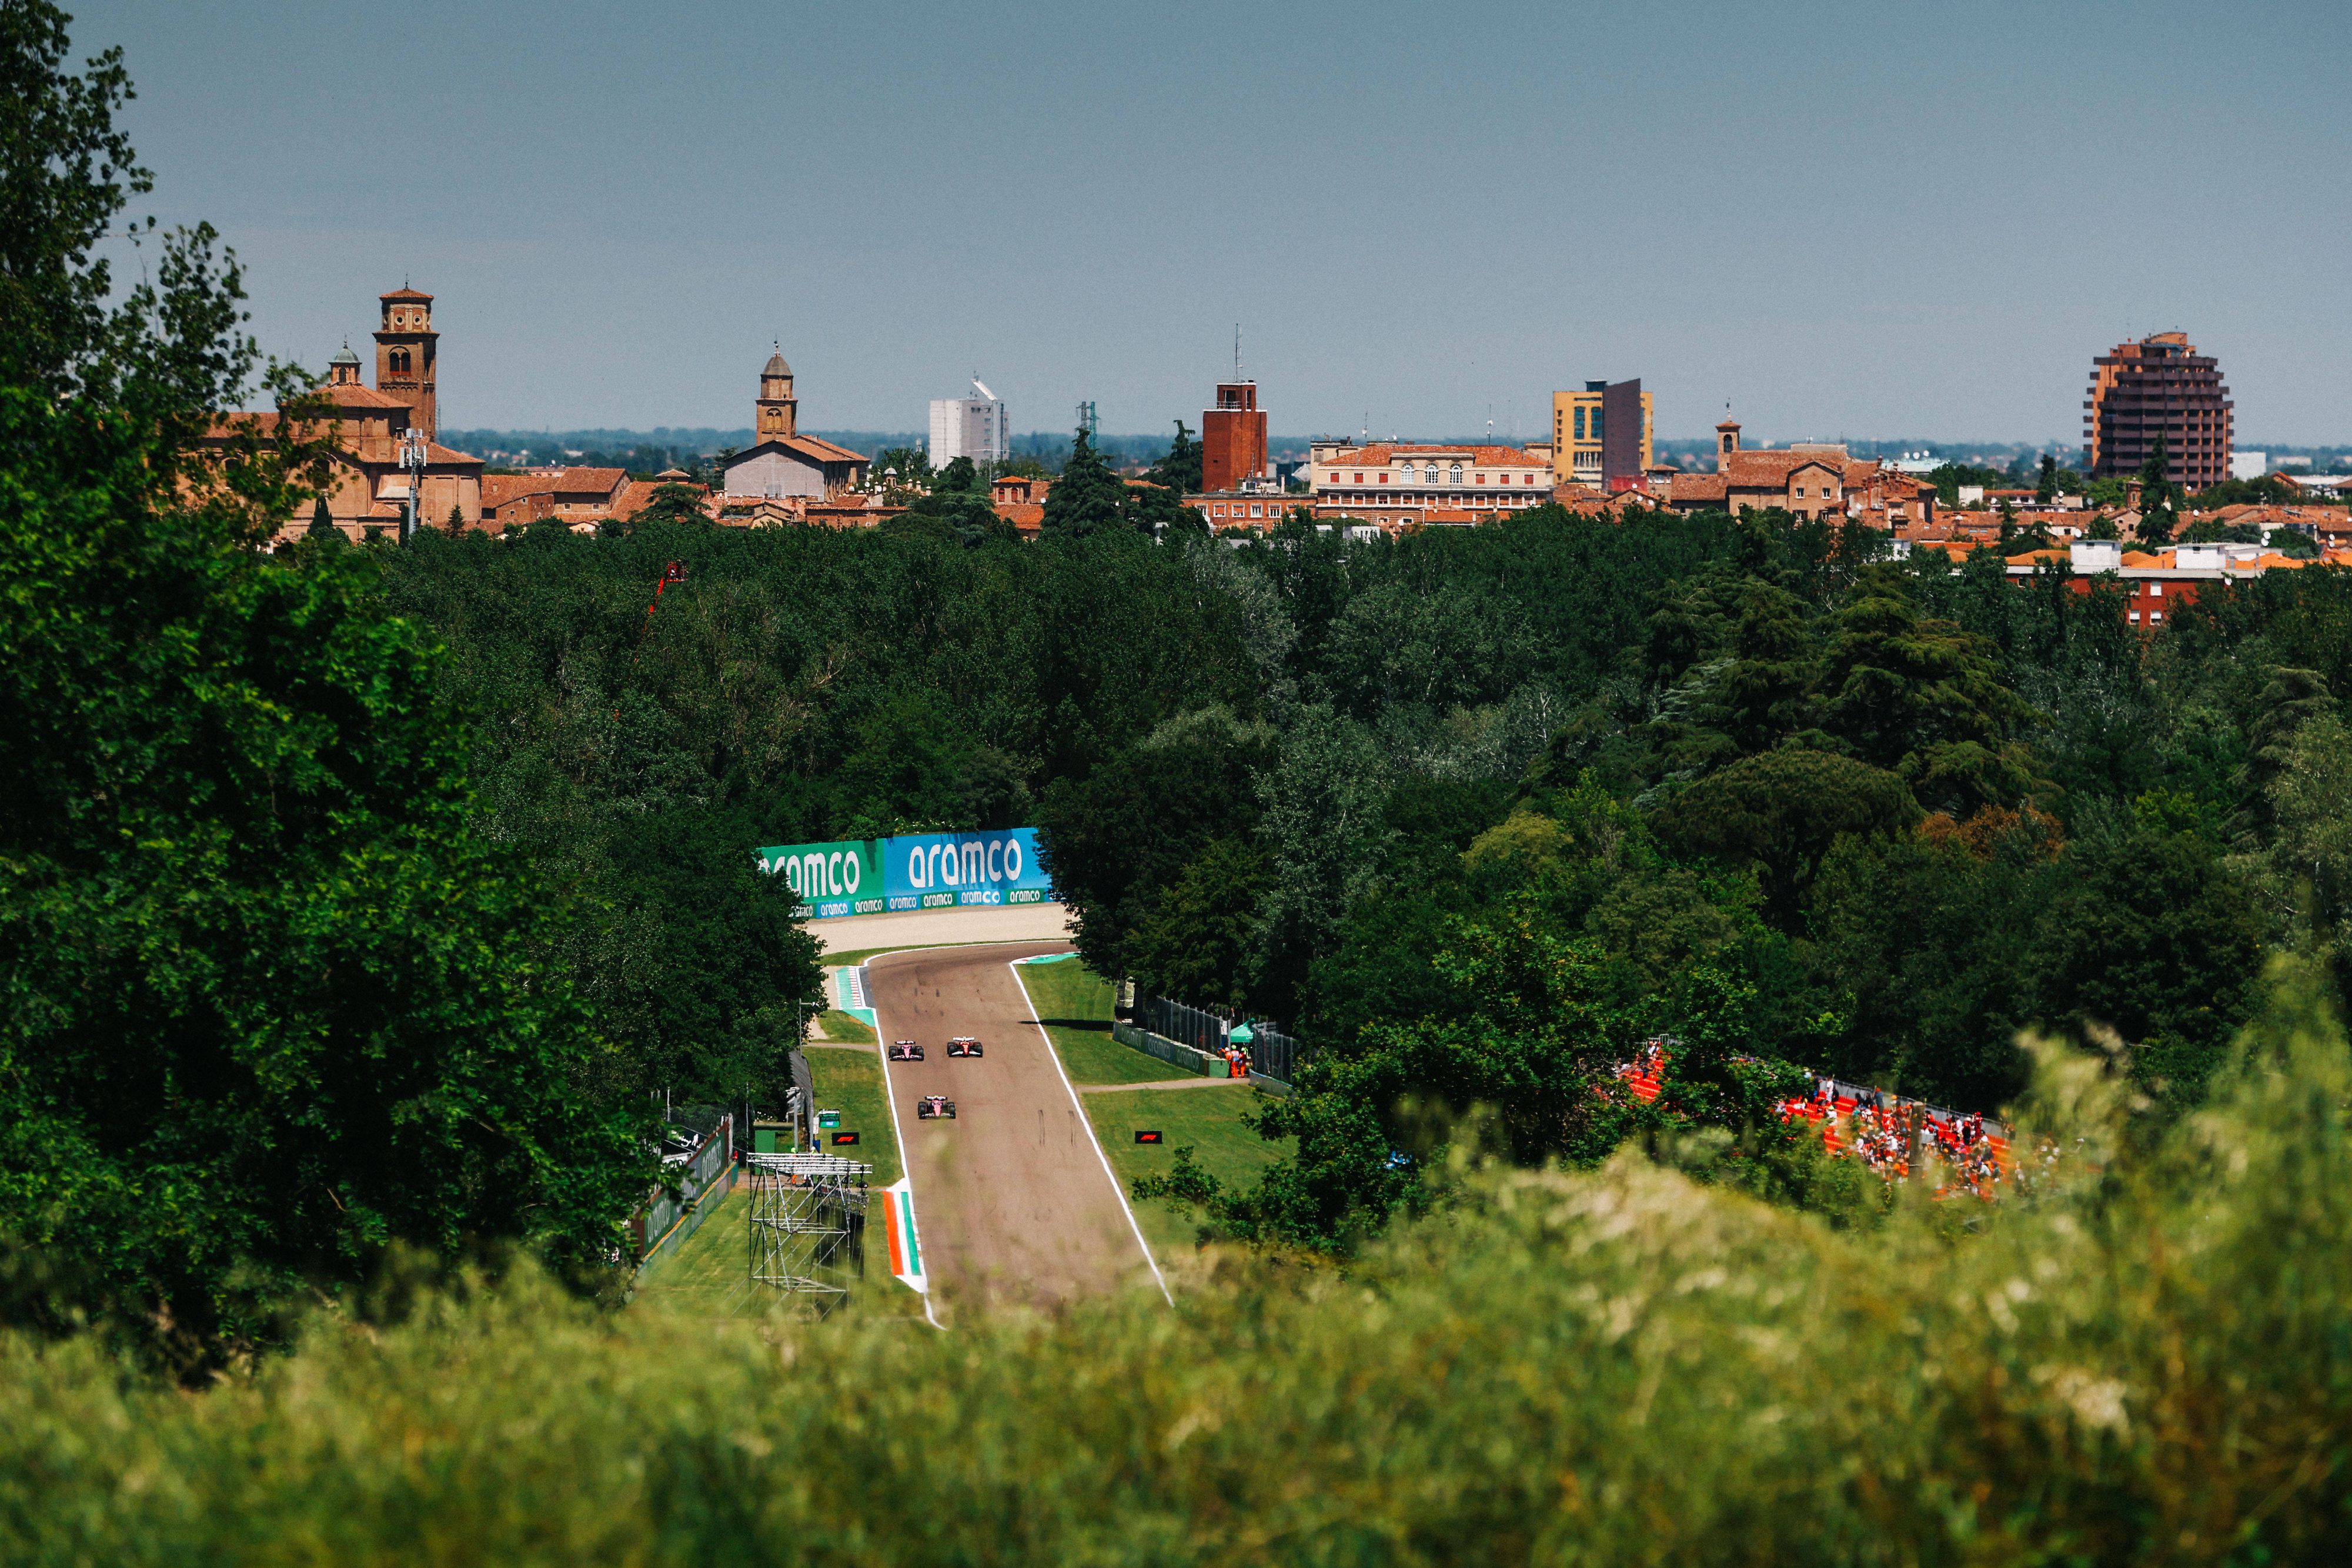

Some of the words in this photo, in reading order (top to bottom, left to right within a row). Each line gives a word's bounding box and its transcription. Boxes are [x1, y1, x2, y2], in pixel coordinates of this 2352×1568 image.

[908, 838, 1022, 888] aramco
[923, 893, 953, 907] aramco
[961, 891, 1000, 904] aramco
[1010, 890, 1040, 902] aramco
[821, 903, 848, 916] aramco
[855, 900, 883, 913] aramco
[889, 897, 917, 910] aramco
